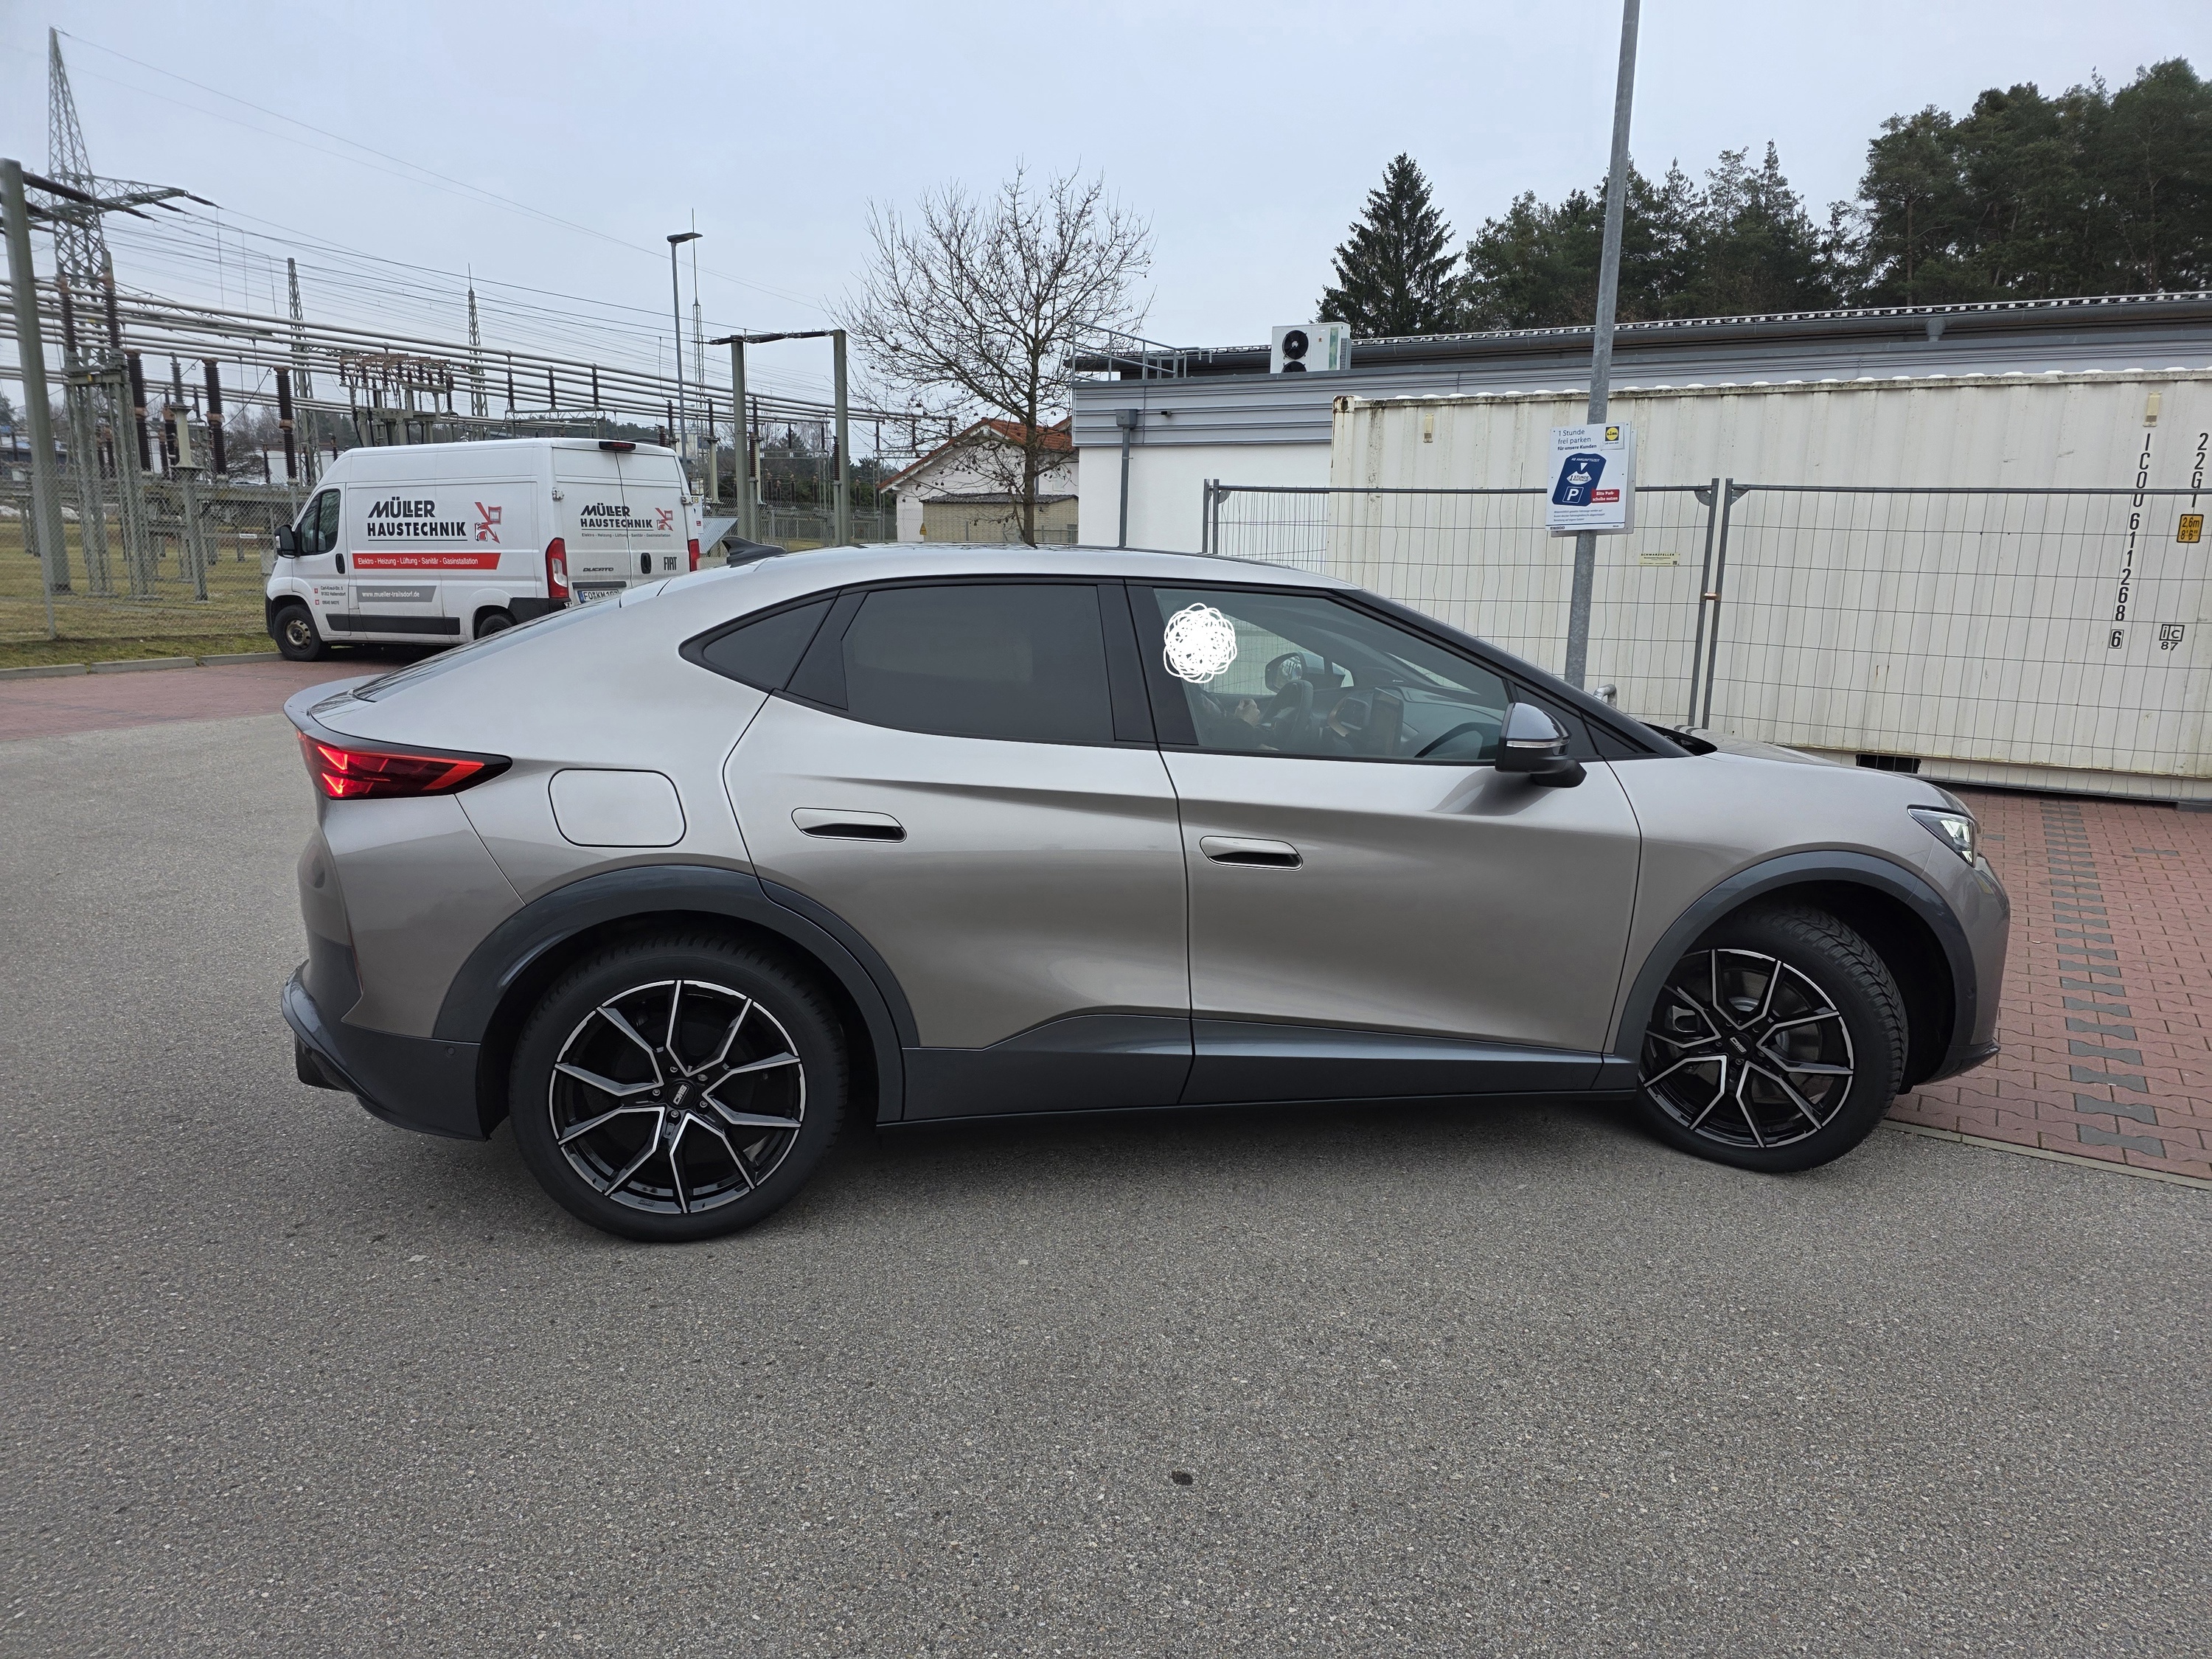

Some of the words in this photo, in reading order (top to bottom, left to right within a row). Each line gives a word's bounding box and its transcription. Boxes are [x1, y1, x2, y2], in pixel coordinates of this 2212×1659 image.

[2191, 432, 2209, 507] 22G1
[1566, 488, 1579, 501] P
[368, 496, 436, 518] MÜLLER
[580, 502, 631, 517] MÜLLER
[367, 521, 467, 537] HAUSTECHNIK
[580, 518, 653, 528] HAUSTECHNIK
[2182, 517, 2200, 529] 2,6m
[377, 557, 397, 566] Heizung
[400, 557, 418, 566] Lüftung
[664, 557, 678, 571] FIAT
[583, 591, 594, 600] FO
[2111, 630, 2122, 647] 6
[2160, 641, 2178, 650] 87
